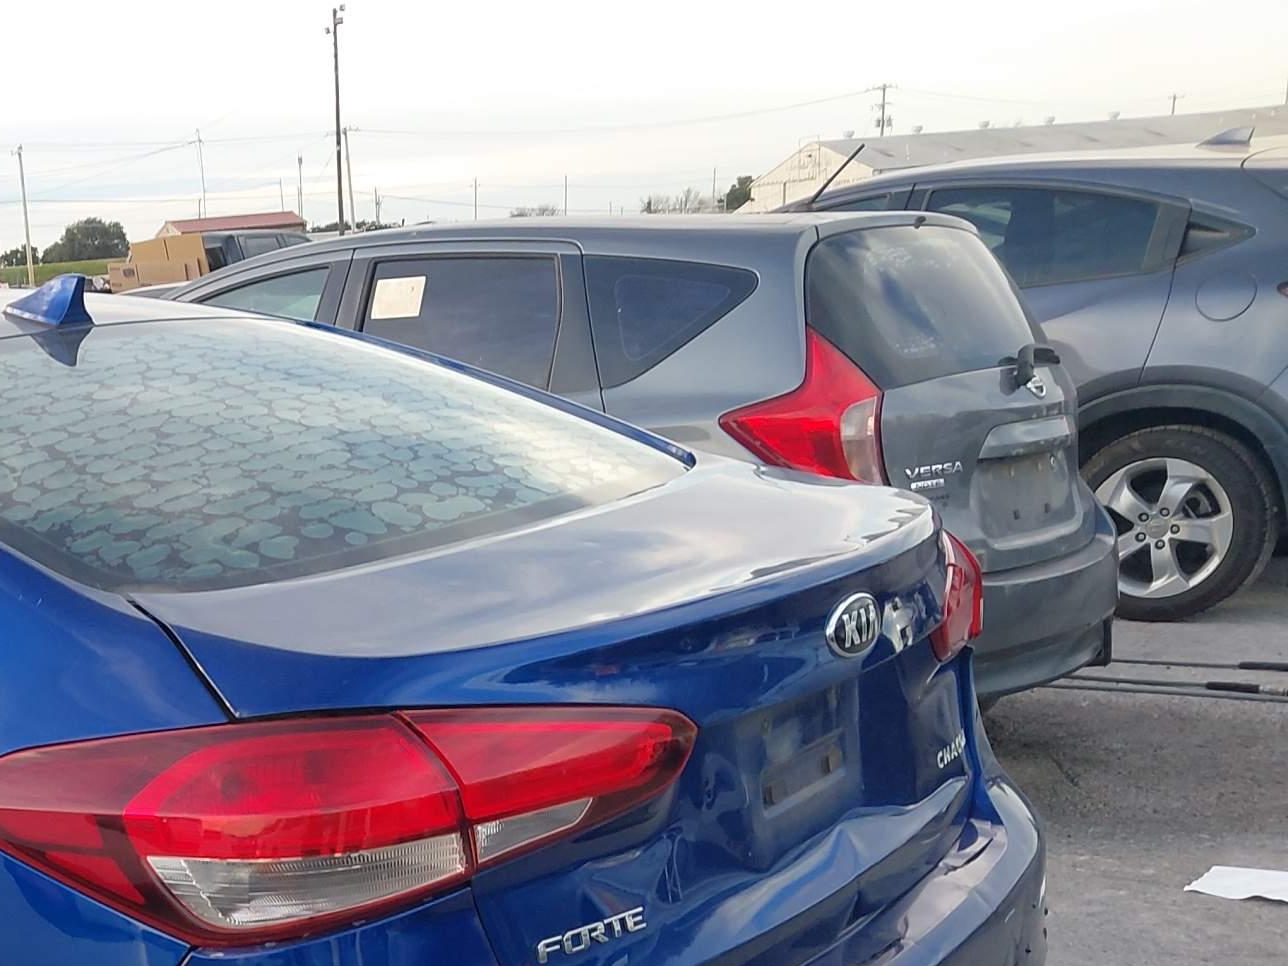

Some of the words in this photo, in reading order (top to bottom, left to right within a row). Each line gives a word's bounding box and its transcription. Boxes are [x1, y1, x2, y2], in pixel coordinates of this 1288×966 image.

[904, 460, 963, 479] VERSA
[840, 601, 879, 649] KIA
[537, 906, 648, 964] FORTE
